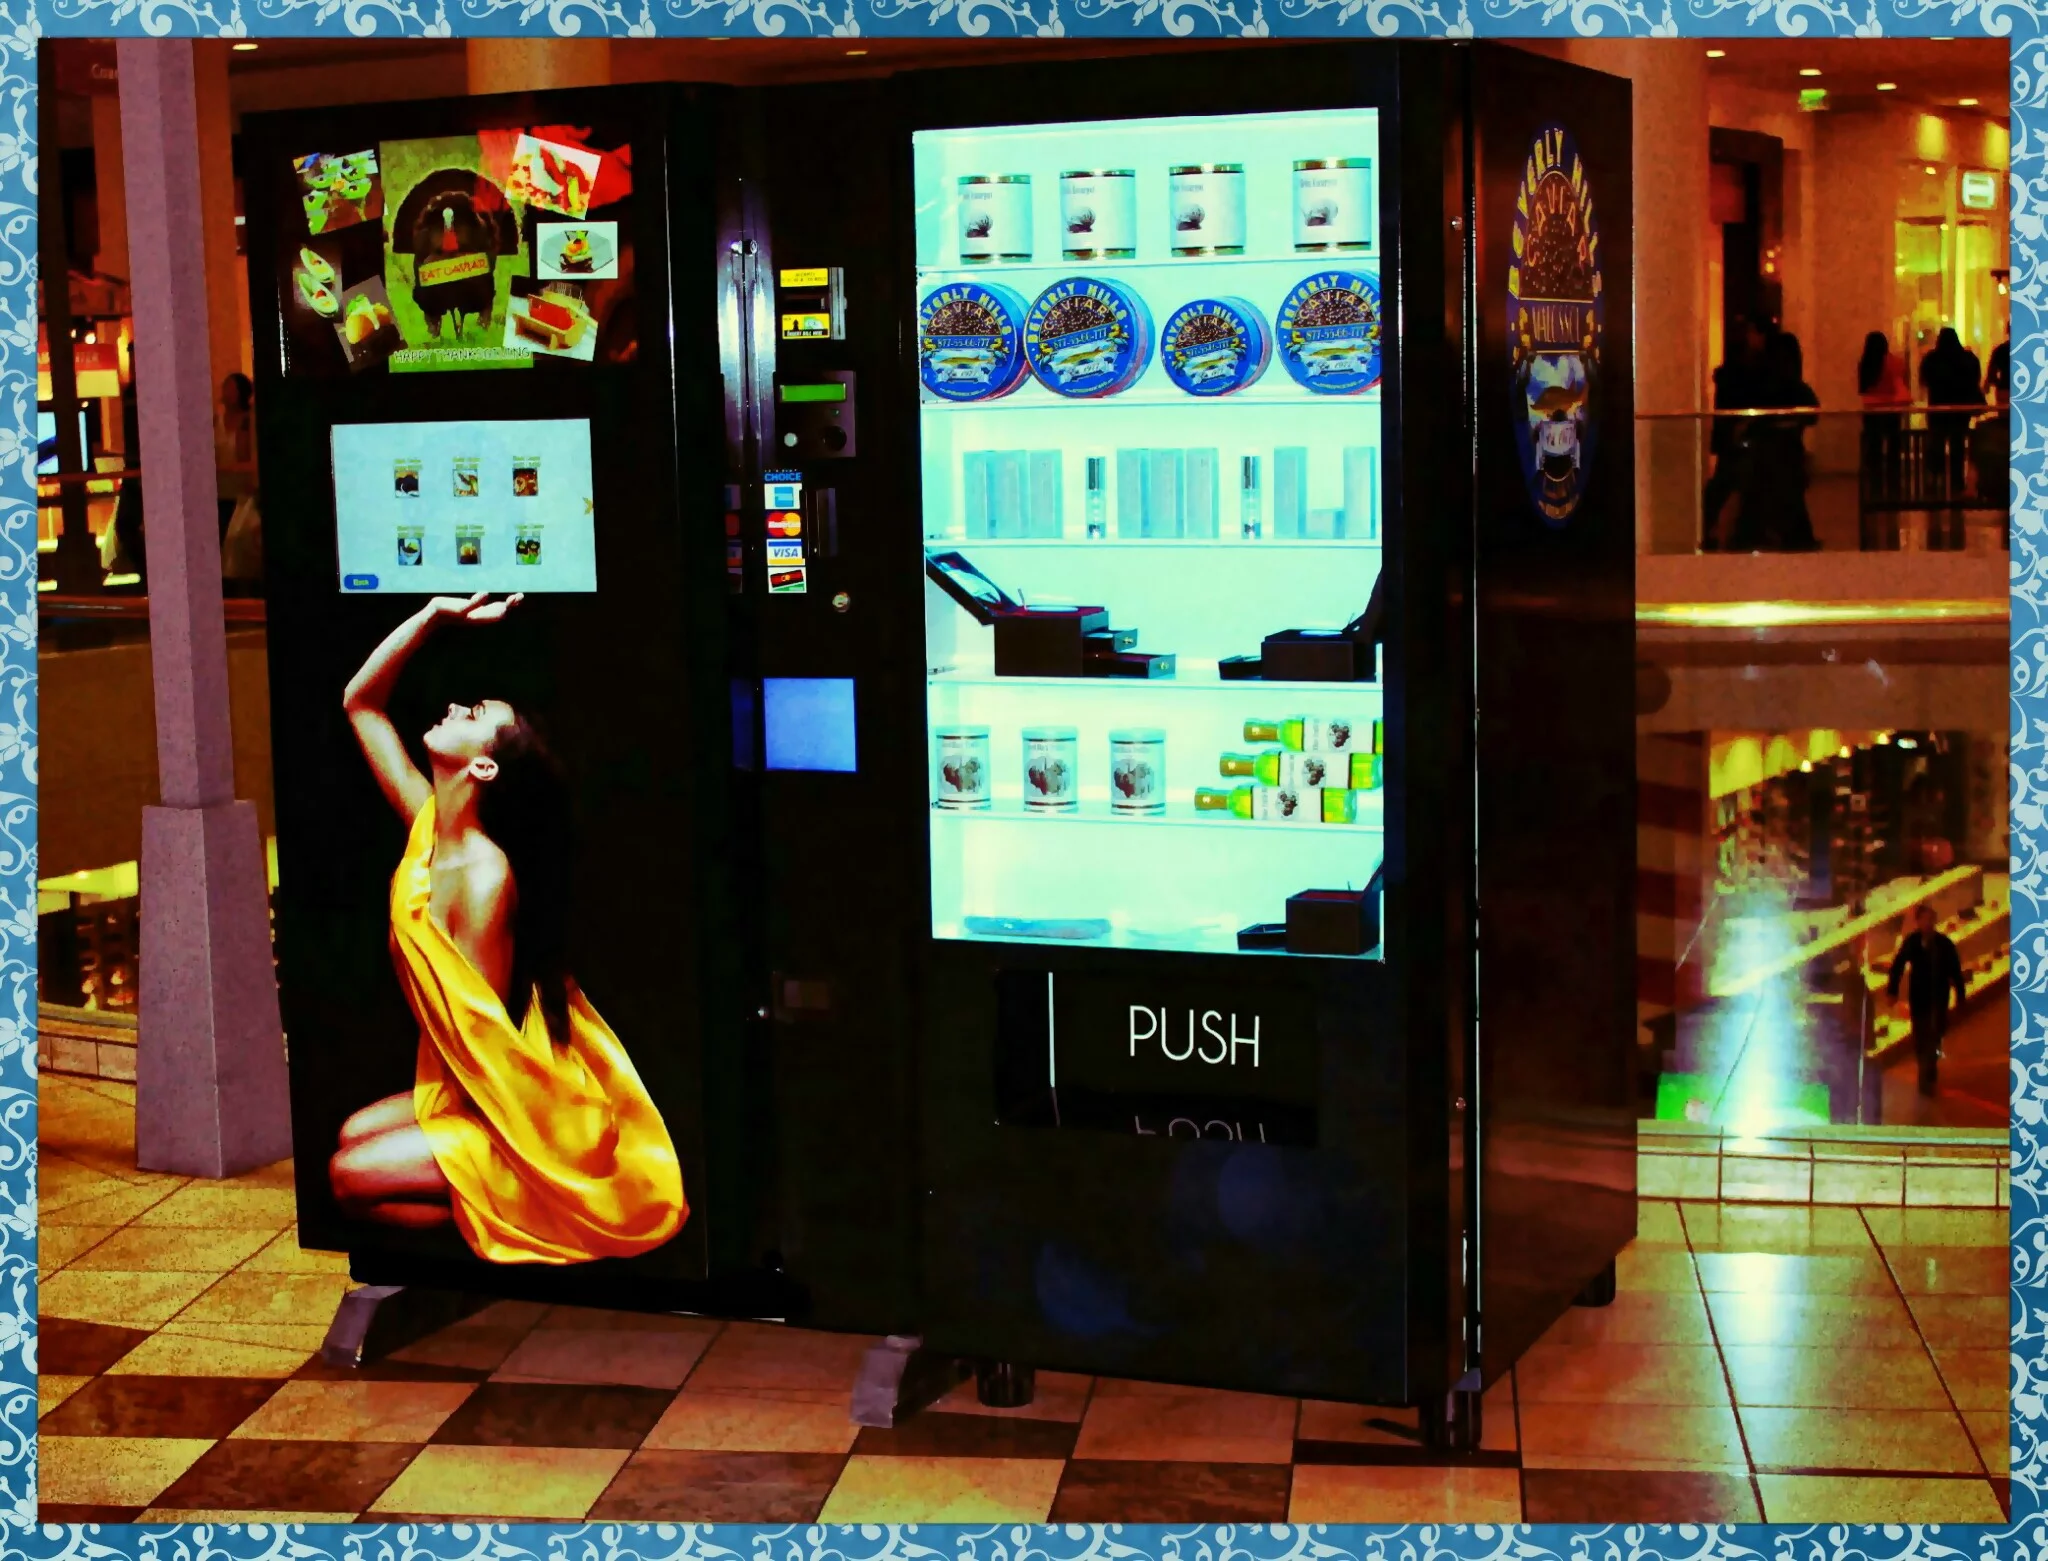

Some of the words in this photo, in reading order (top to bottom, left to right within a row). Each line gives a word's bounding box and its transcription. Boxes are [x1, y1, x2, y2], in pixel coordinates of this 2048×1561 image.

[932, 302, 995, 328] CAVIAR
[979, 293, 1012, 336] HILLS
[1044, 298, 1108, 331] CAVIAR
[1086, 284, 1127, 320] HILLS
[1299, 291, 1369, 320] CAVIAR
[1178, 316, 1230, 343] CAVIAR
[394, 349, 432, 363] HAPPY
[764, 472, 802, 482] CHOICE
[774, 547, 799, 558] VISA
[1130, 1005, 1260, 1068] PUSH
